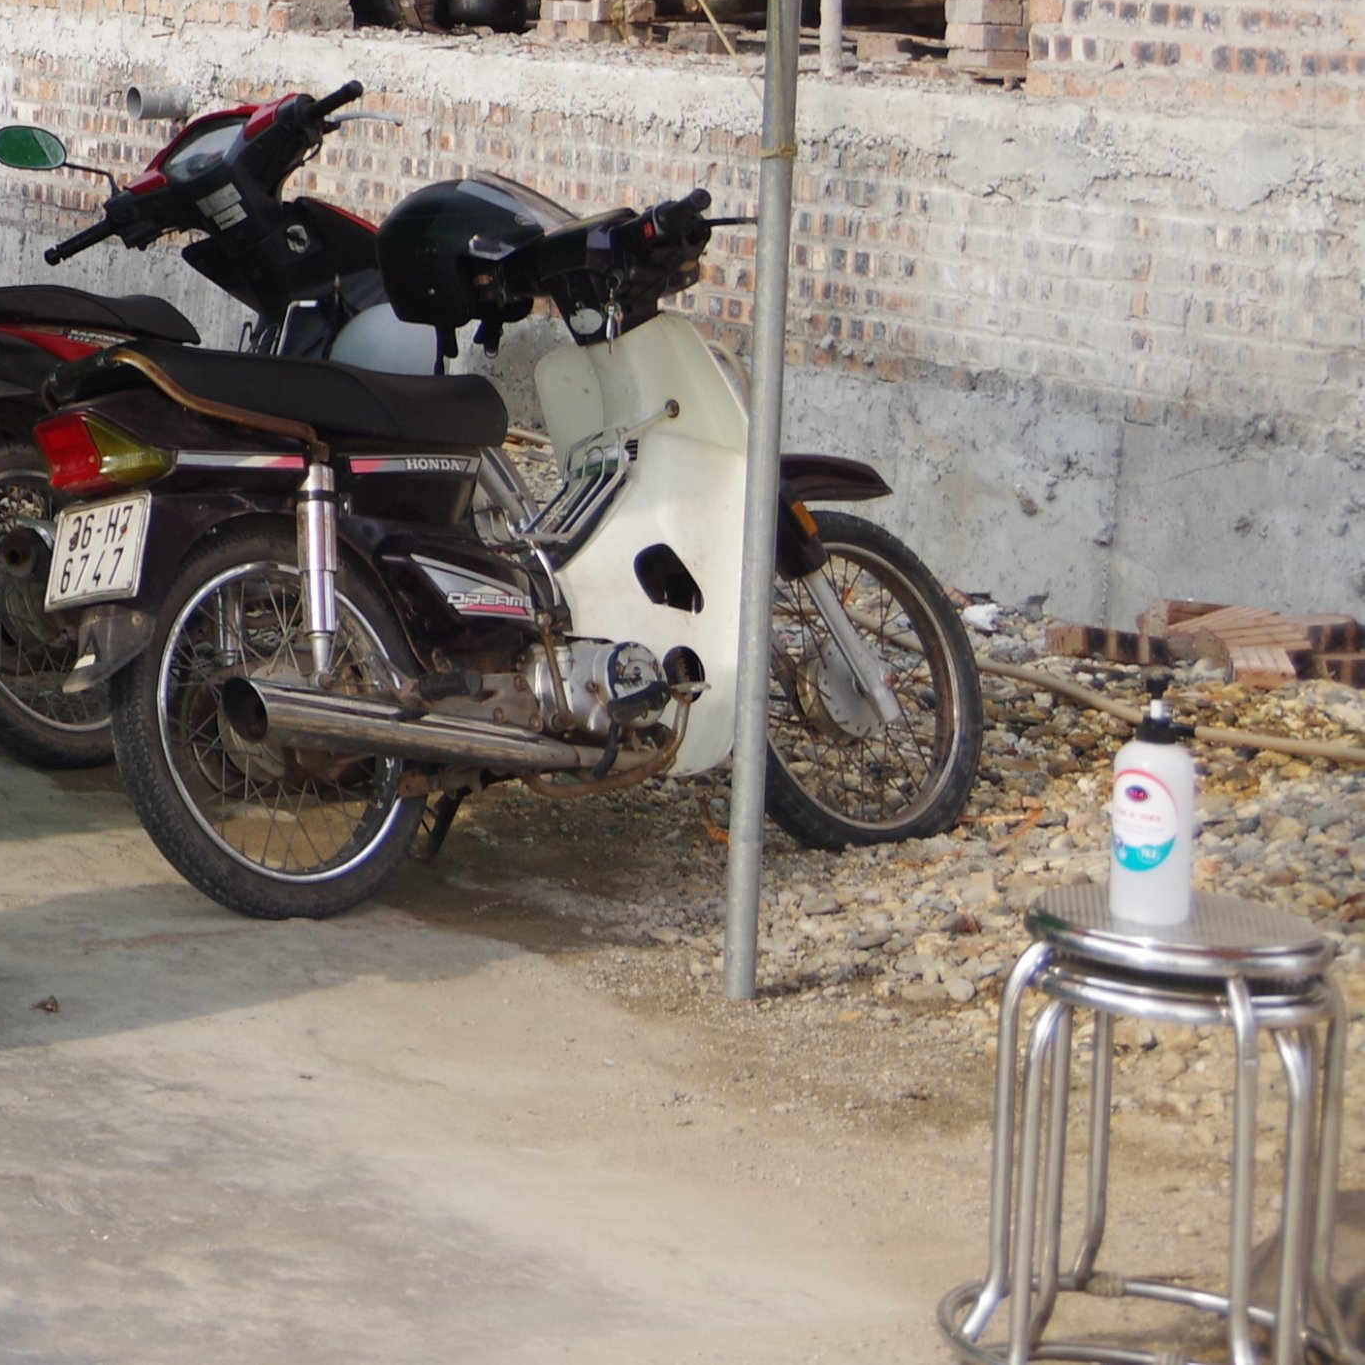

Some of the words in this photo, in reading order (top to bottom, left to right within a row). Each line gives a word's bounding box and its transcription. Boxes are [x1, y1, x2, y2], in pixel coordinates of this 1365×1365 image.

[405, 458, 461, 471] HONDA
[60, 546, 124, 594] 6747
[447, 592, 523, 608] DREAM
